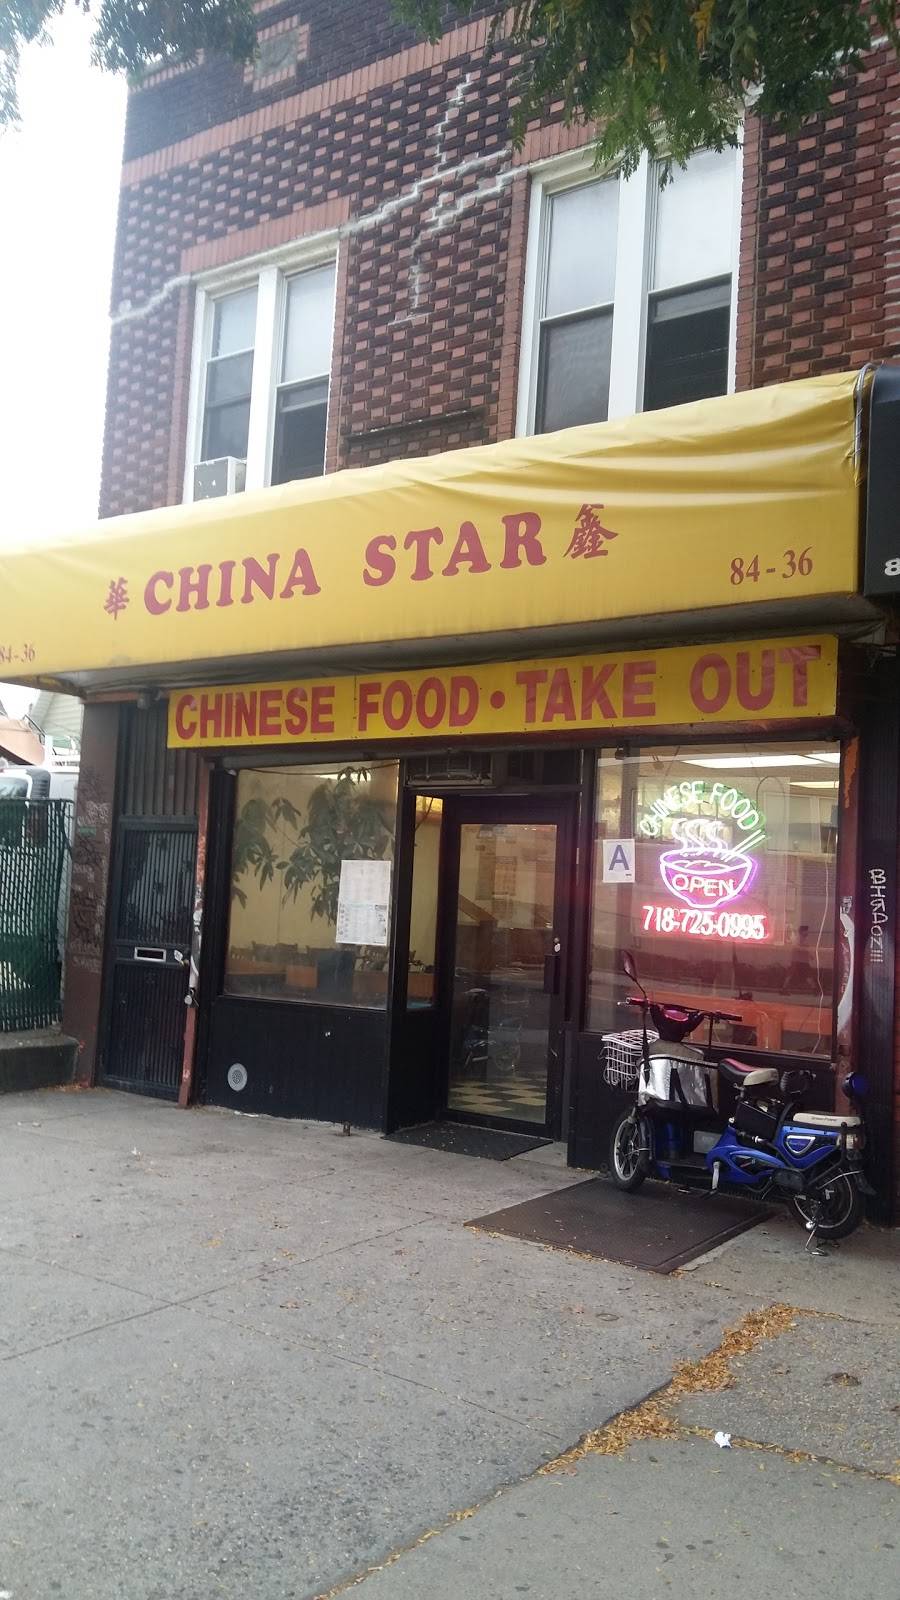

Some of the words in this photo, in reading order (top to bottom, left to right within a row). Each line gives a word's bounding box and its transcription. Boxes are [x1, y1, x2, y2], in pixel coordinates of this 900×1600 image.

[562, 503, 619, 559] 鑫
[143, 547, 322, 616] CHINA
[362, 511, 548, 587] STAR
[730, 546, 814, 586] 84-36
[174, 685, 336, 741] CHINESE
[357, 674, 480, 735] FOOD
[515, 660, 657, 724] TAKE
[689, 644, 822, 714] OUT
[639, 780, 705, 836] CHINESE
[709, 782, 760, 830] FOOD
[608, 844, 630, 871] A
[671, 873, 735, 897] OPEN
